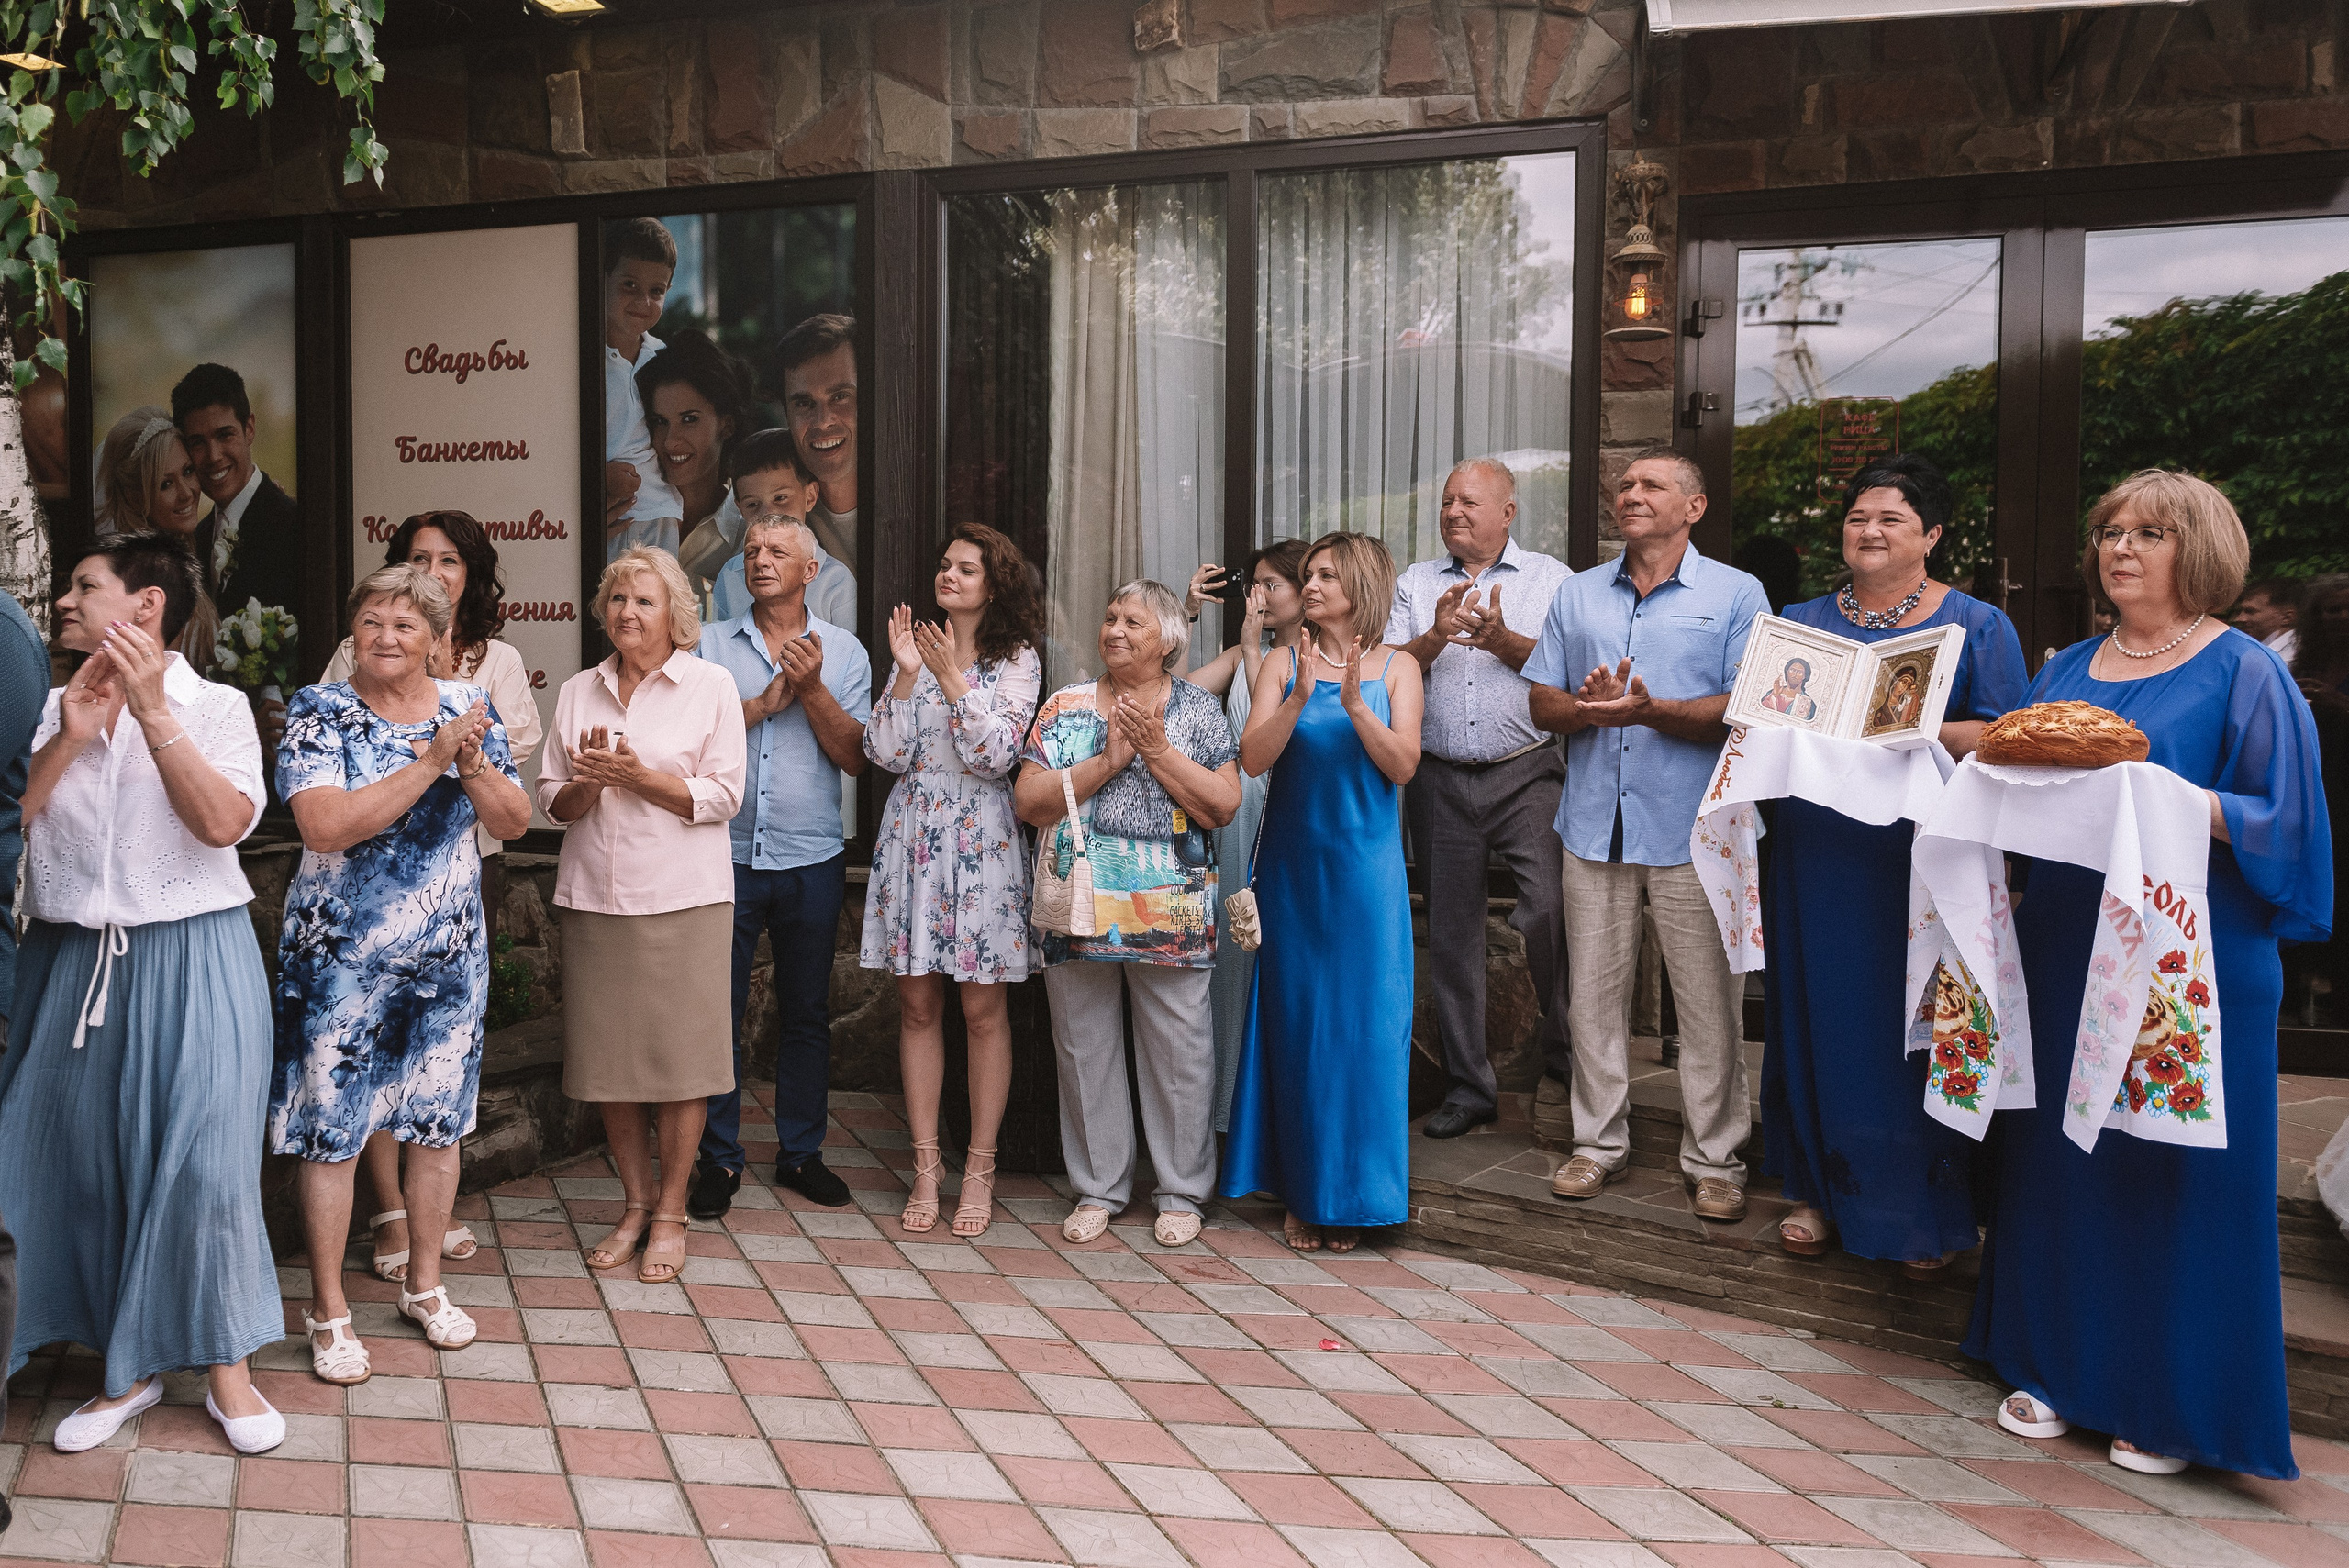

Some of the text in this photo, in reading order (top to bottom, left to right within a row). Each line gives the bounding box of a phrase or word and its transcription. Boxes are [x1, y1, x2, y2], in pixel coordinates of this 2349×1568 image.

[404, 339, 529, 384] Свадьбы
[1845, 414, 1876, 422] КАФЕ
[395, 435, 530, 463] Банкеты
[362, 509, 568, 543] Котивы
